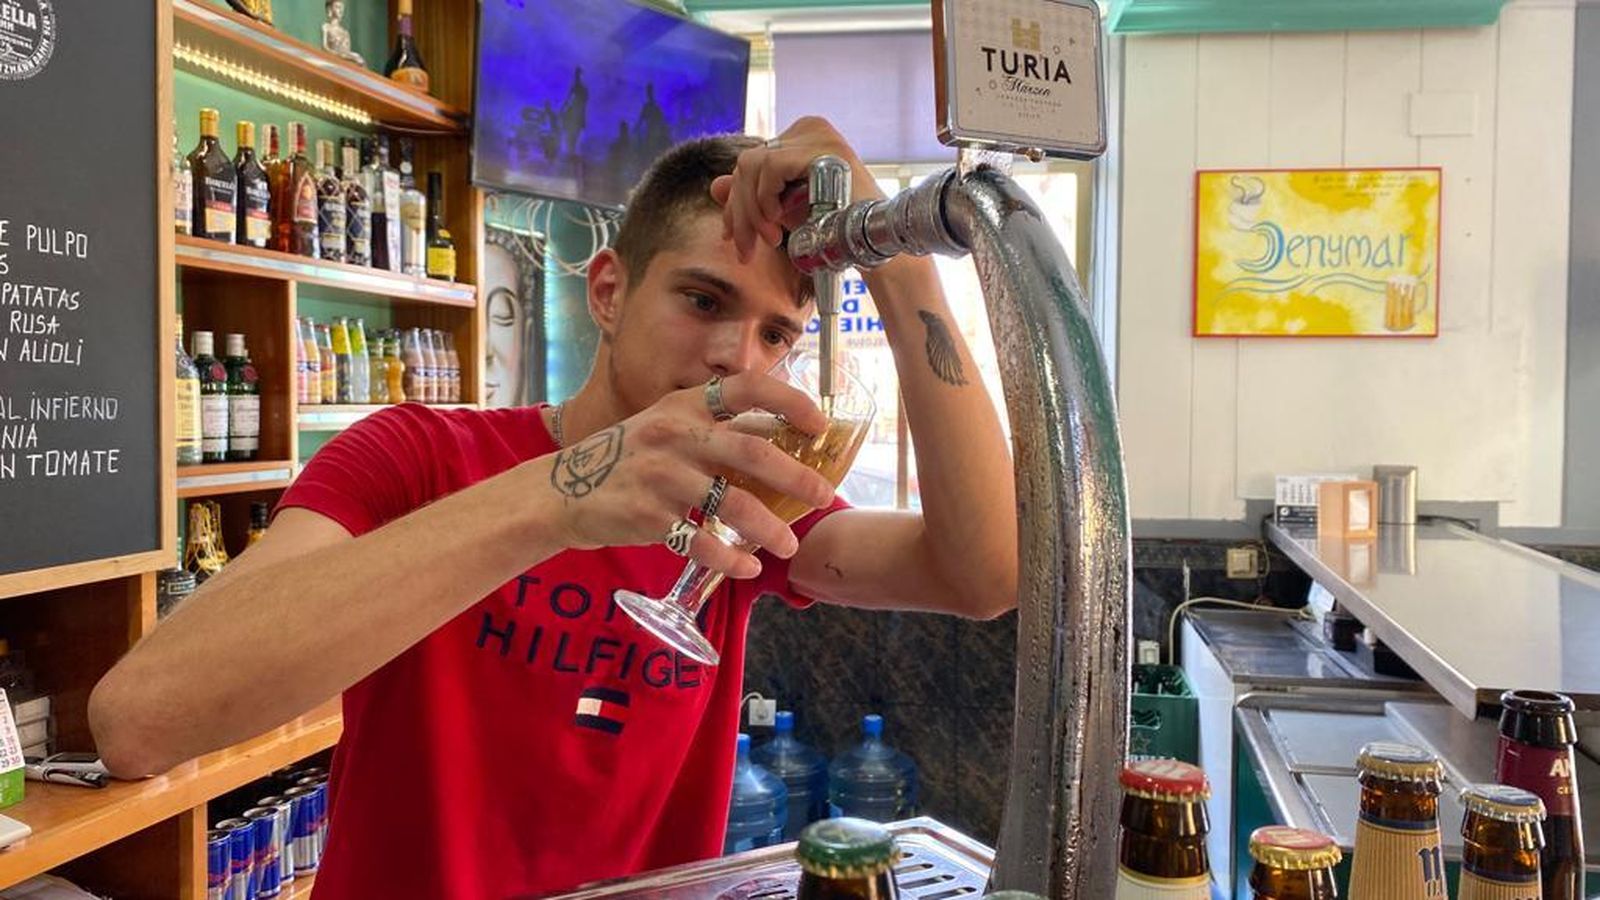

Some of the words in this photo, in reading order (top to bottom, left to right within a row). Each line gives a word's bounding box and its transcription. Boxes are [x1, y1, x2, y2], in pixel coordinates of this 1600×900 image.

[981, 47, 1072, 84] TURIA
[27, 224, 88, 258] PULPO
[1237, 221, 1414, 273] Denymar
[2, 282, 80, 311] PATATAS
[10, 310, 61, 335] RUSA
[26, 449, 120, 477] TOMATE
